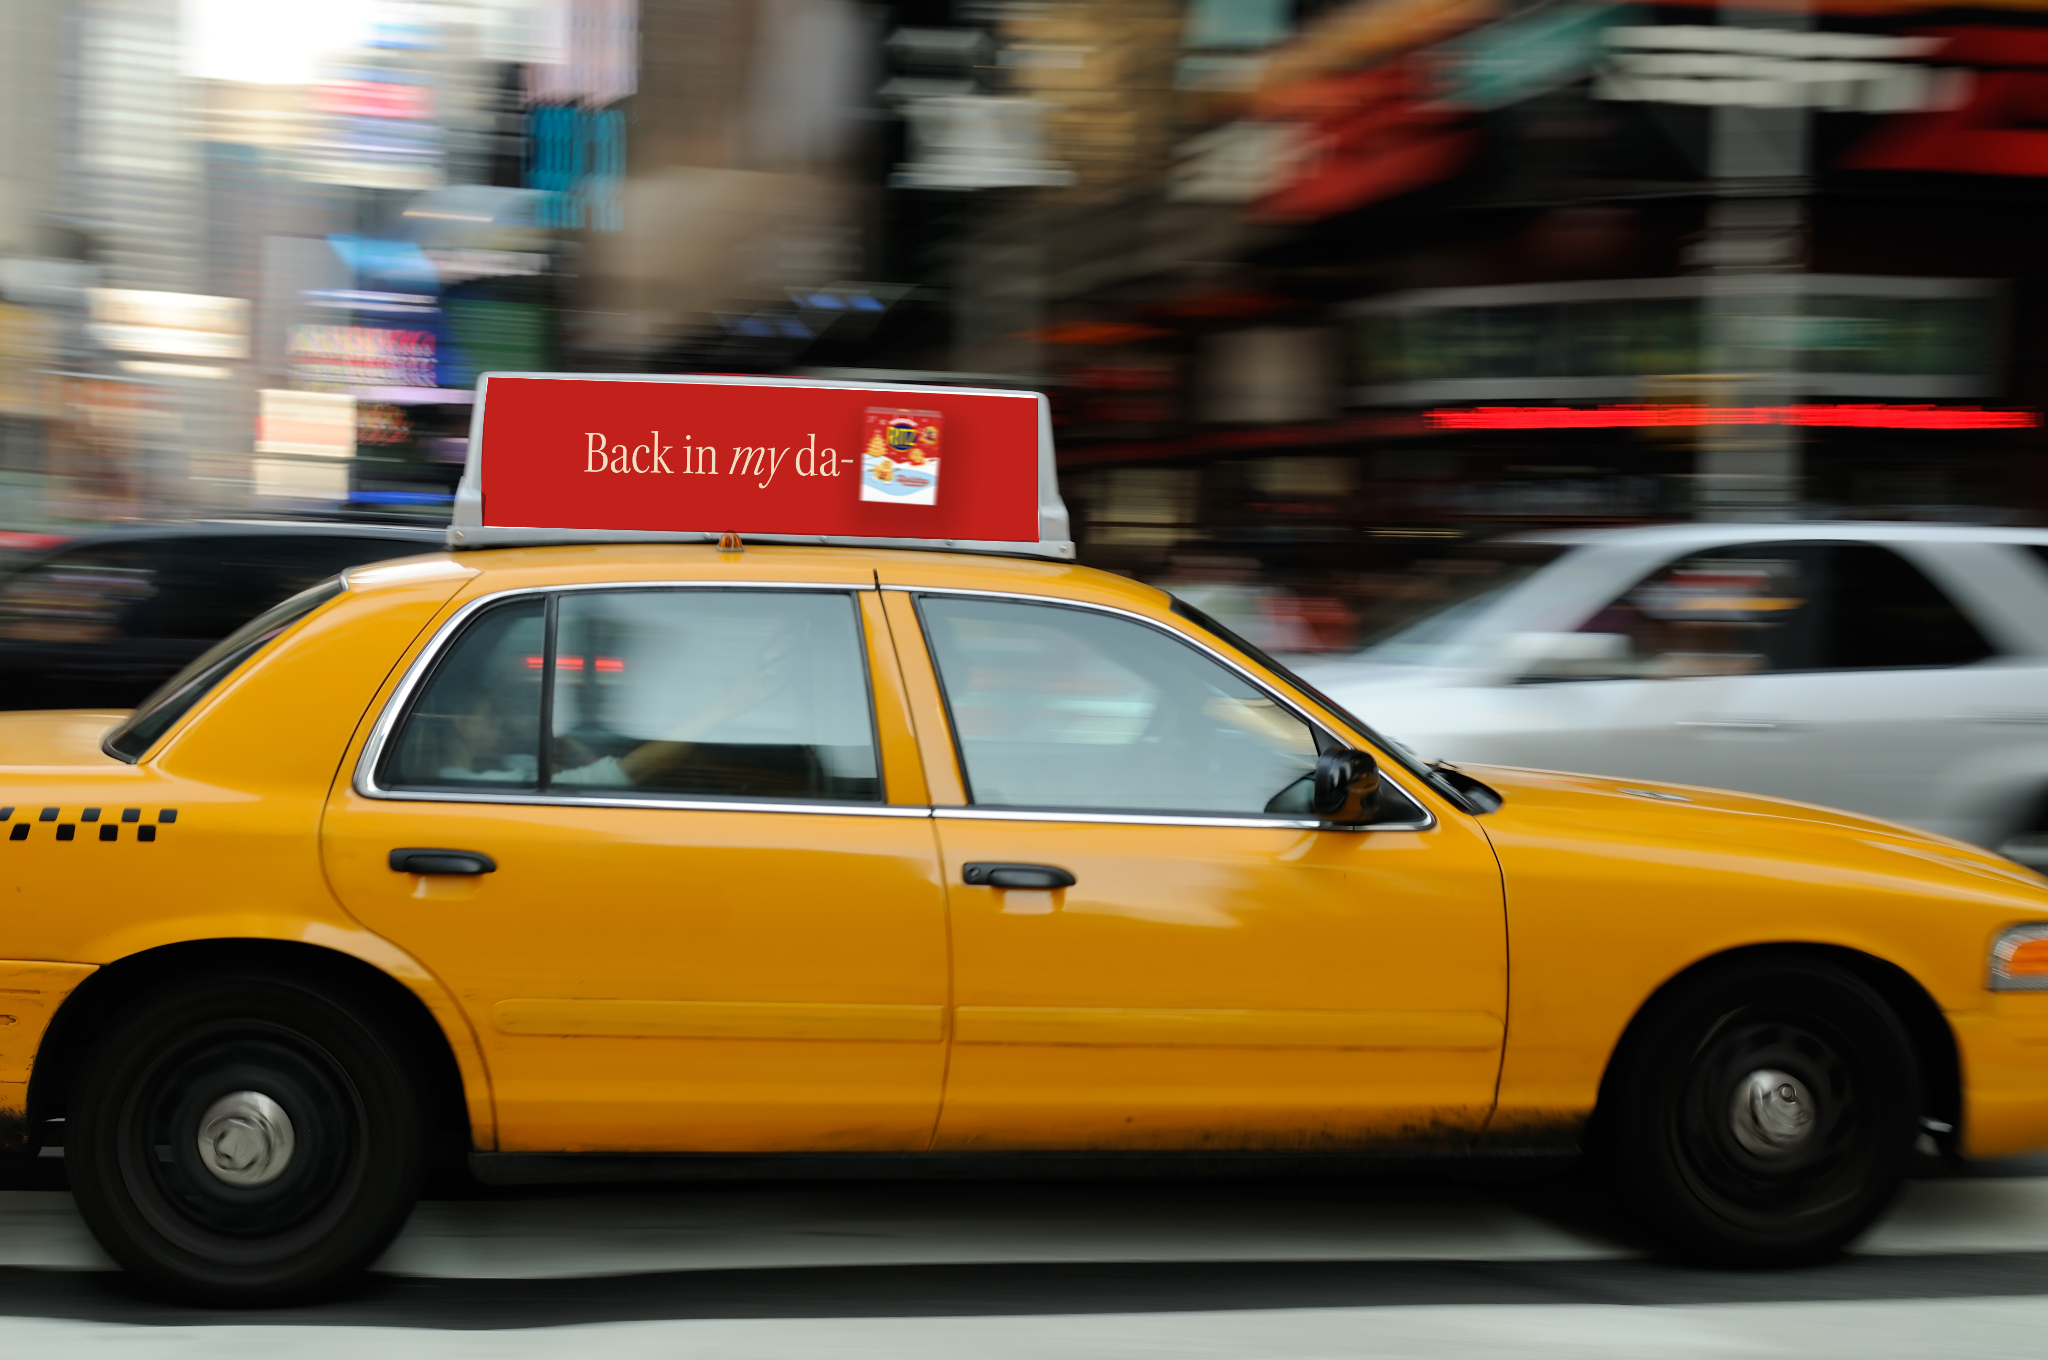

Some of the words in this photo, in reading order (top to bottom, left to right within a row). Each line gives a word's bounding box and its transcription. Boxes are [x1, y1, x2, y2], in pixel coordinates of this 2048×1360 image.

[583, 430, 675, 475] Back
[682, 434, 719, 475] in
[728, 445, 791, 489] my
[795, 433, 854, 477] da-
